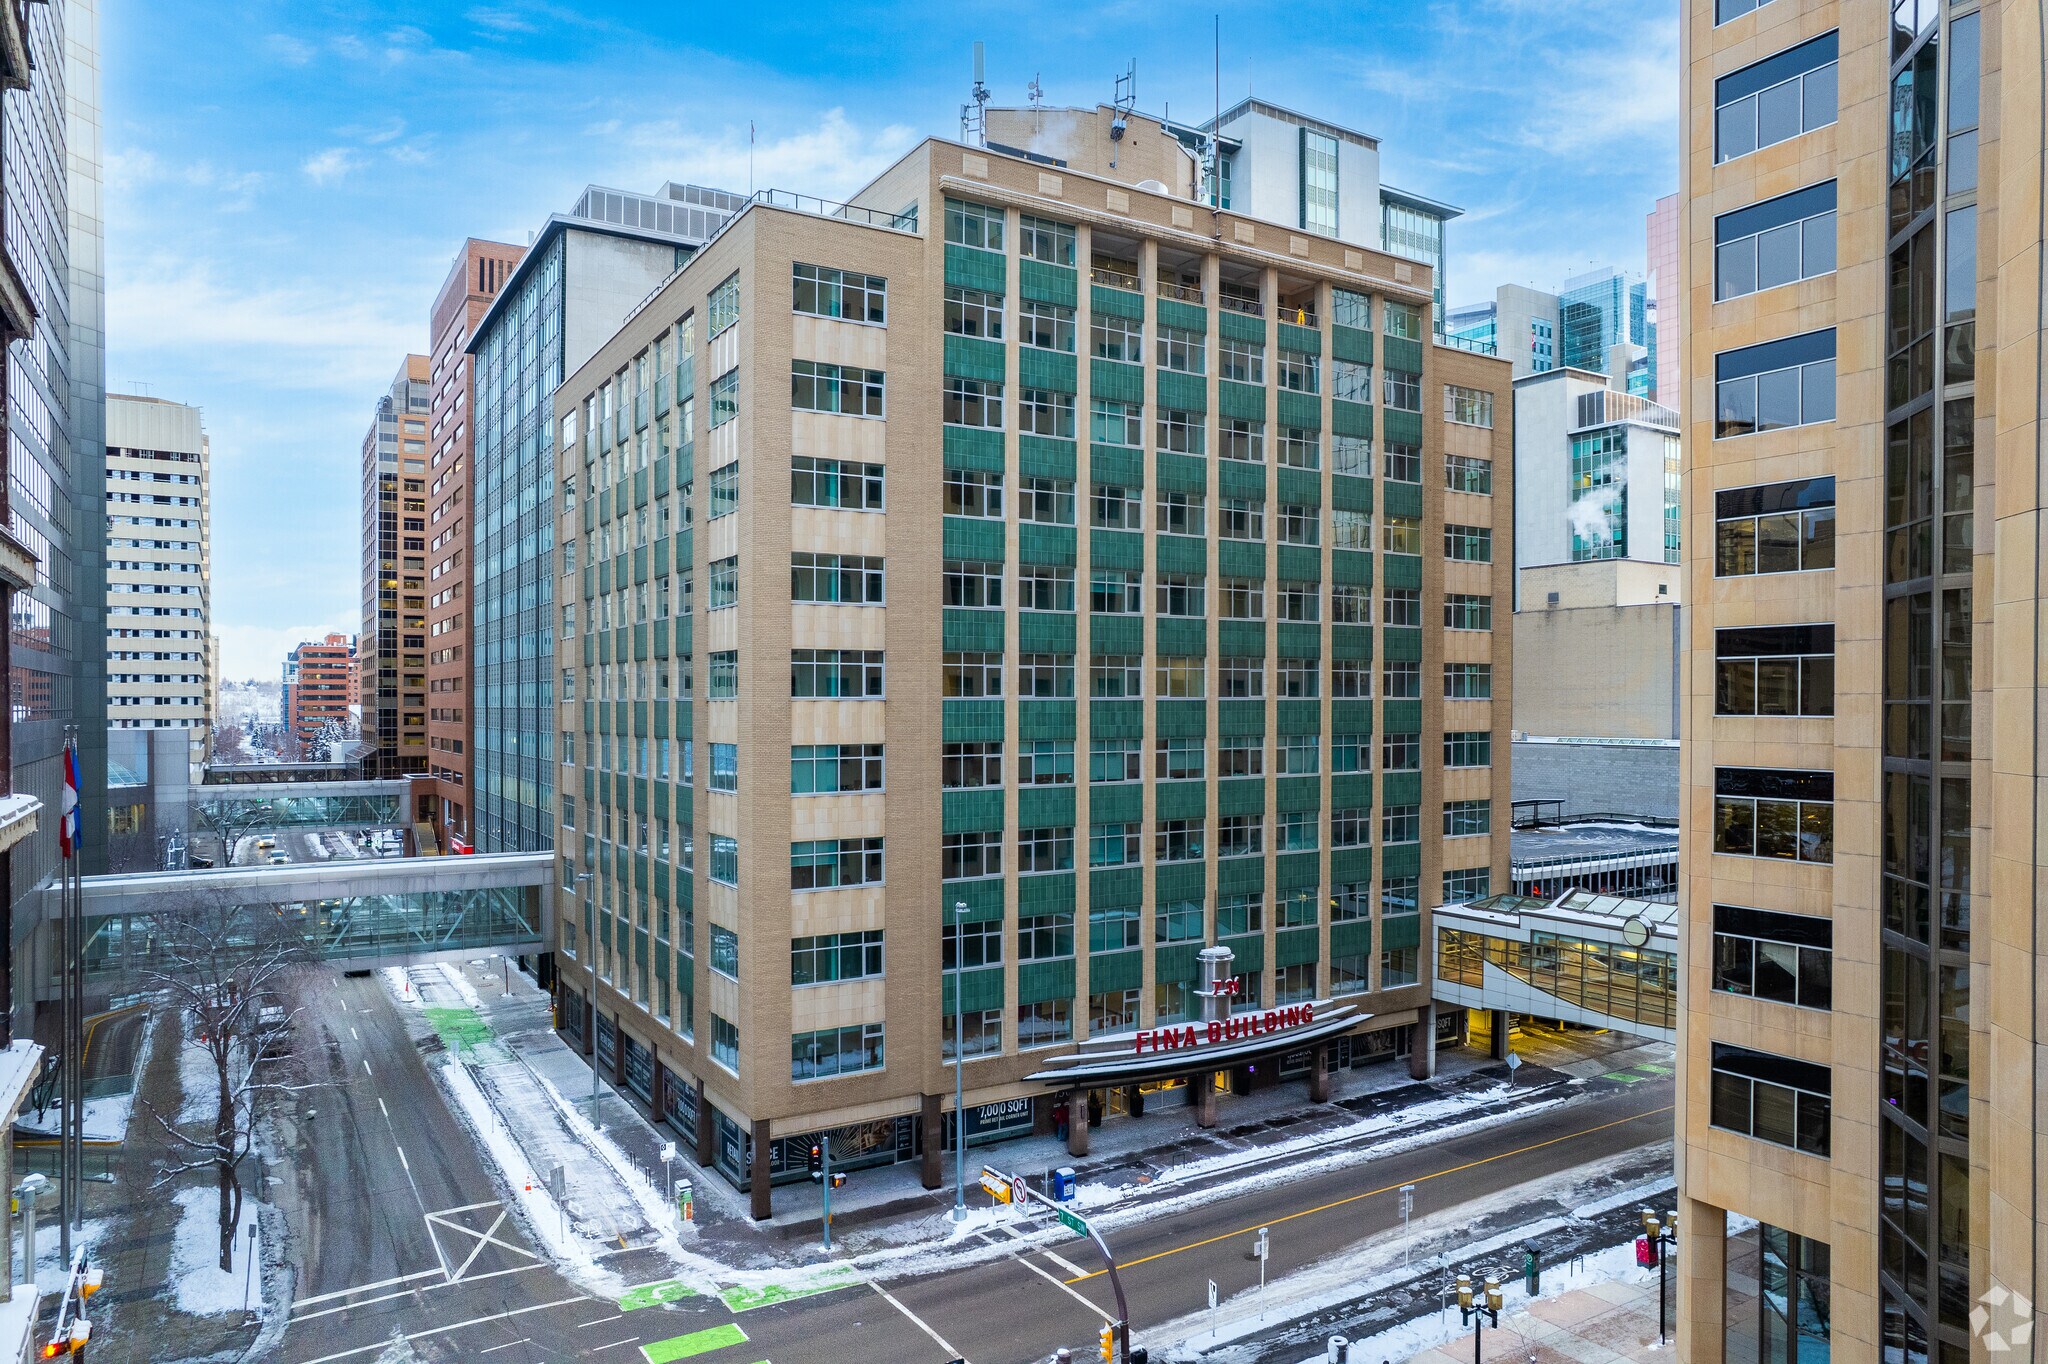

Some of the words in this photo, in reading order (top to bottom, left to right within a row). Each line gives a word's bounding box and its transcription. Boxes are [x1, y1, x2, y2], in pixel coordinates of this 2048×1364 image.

[1135, 1026, 1198, 1054] FINA
[1207, 1003, 1313, 1044] BUILDING
[1007, 1098, 1029, 1112] SQFT
[1060, 1211, 1064, 1221] 7
[1067, 1216, 1075, 1227] ST
